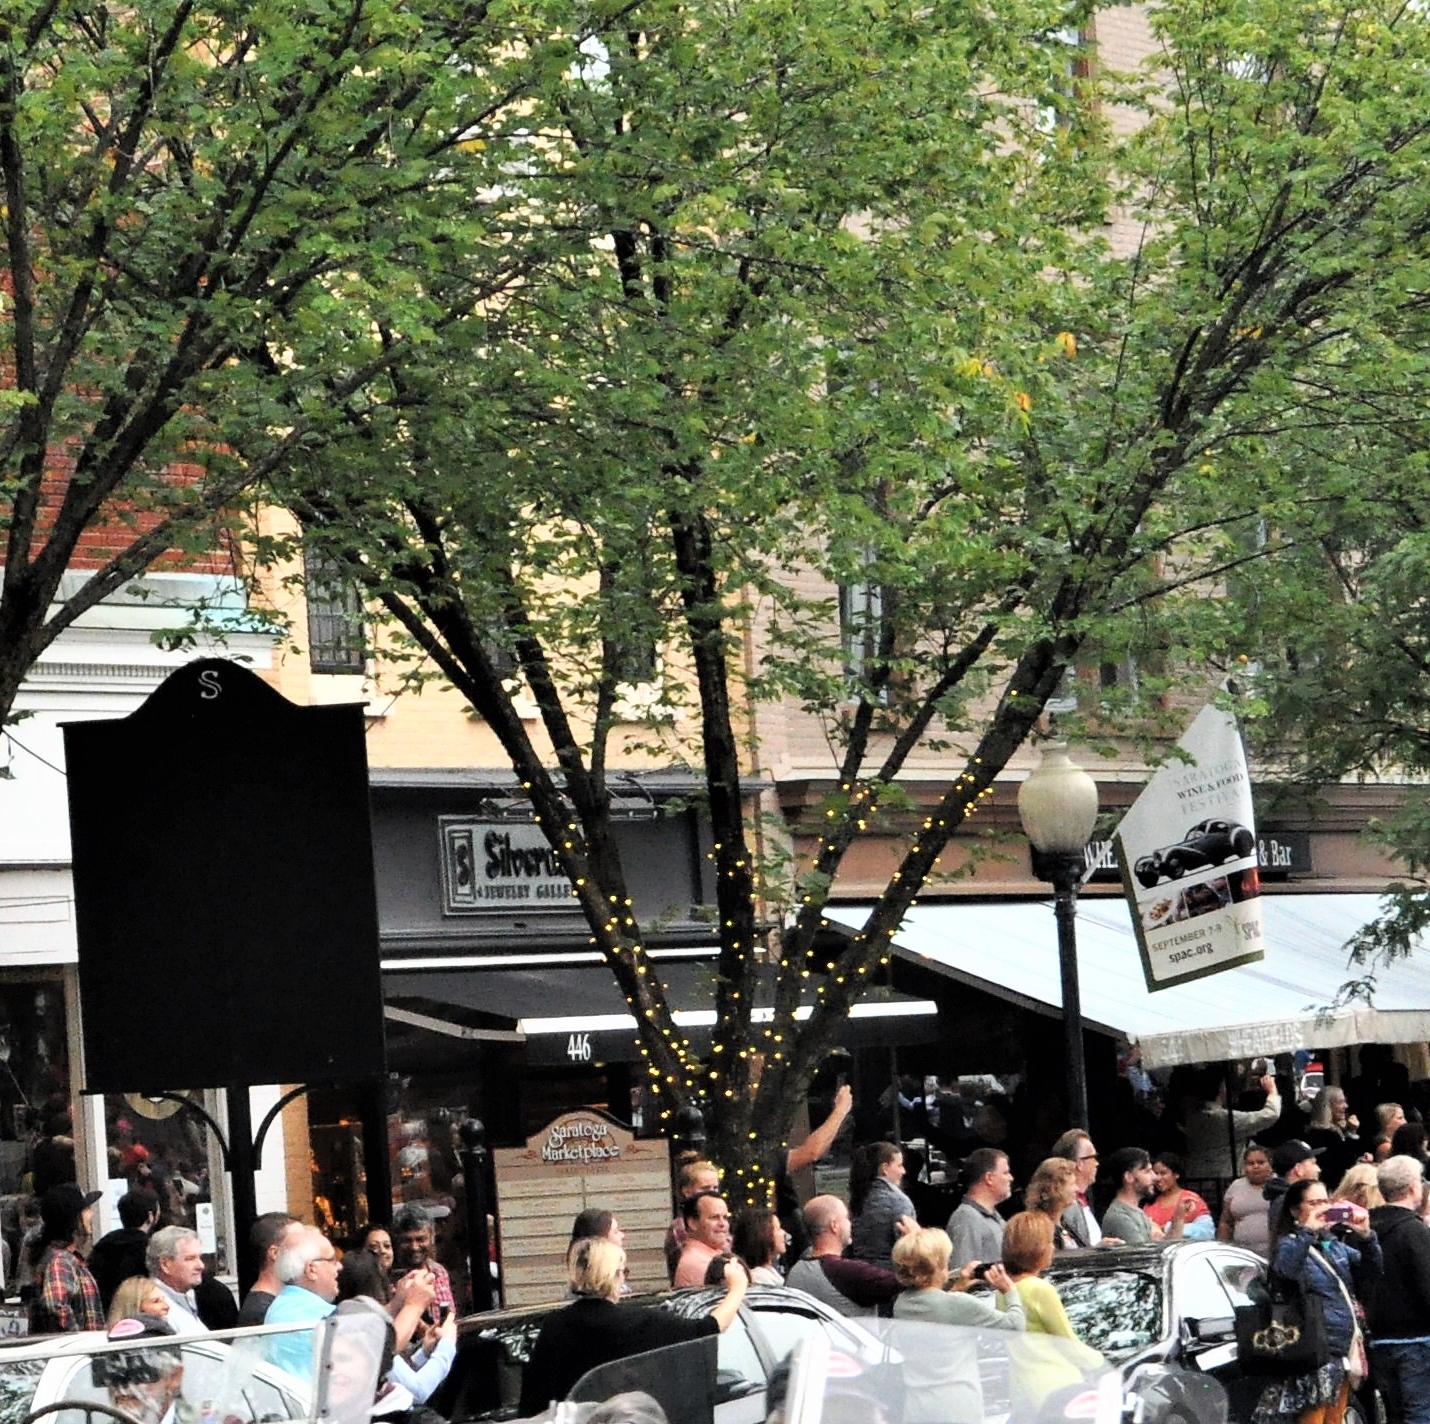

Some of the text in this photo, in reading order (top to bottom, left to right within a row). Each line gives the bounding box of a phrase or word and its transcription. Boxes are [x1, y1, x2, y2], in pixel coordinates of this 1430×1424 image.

[1177, 785, 1208, 799] WINE
[1217, 773, 1244, 788] FOOD
[484, 829, 570, 880] Silver
[1259, 840, 1269, 867] &
[1272, 840, 1292, 867] Bar
[537, 884, 571, 899] GALLE
[1151, 929, 1207, 952] SEPTEMBER
[1169, 942, 1214, 963] spac.org
[567, 1034, 591, 1062] 446
[549, 1122, 608, 1149] Saratoga
[542, 1142, 620, 1164] Marketplace
